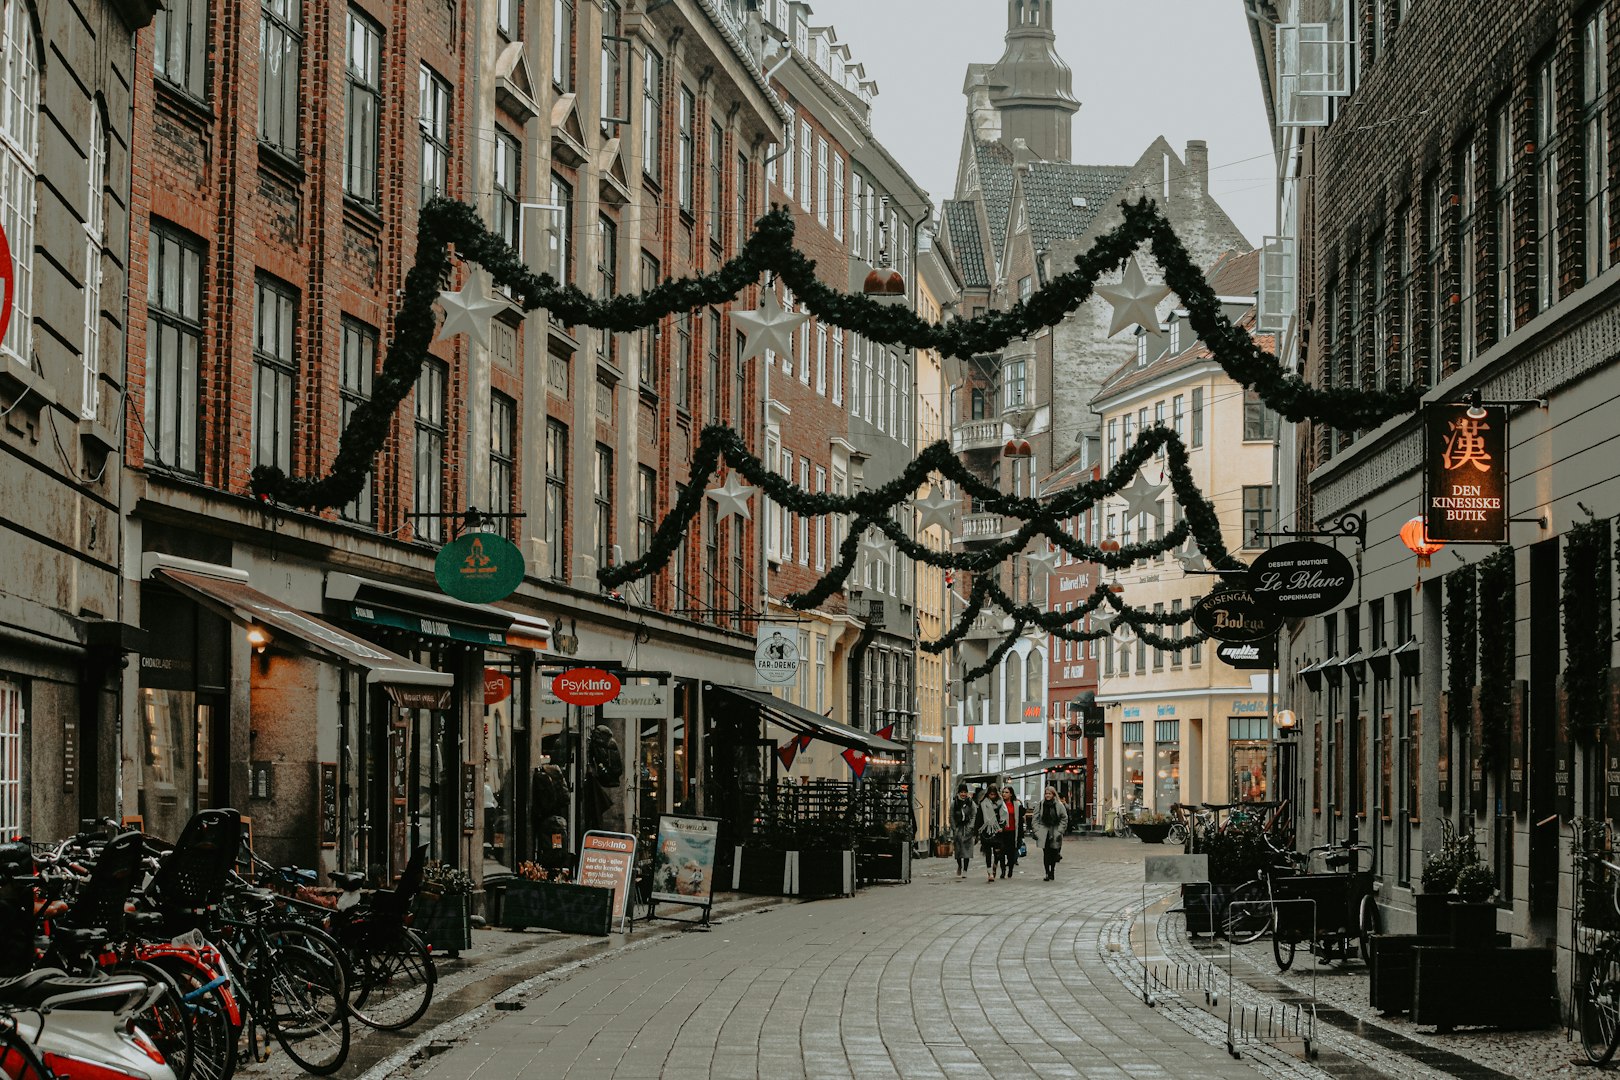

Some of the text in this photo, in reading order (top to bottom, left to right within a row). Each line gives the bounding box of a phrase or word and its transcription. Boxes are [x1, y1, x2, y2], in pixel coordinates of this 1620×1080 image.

[1442, 419, 1491, 472] 漢
[1452, 485, 1480, 496] DEN
[1432, 497, 1500, 509] KINESISKE
[1446, 510, 1487, 521] BUTIK
[1268, 558, 1329, 568] DESSERT BOUTIQUE
[1254, 569, 1345, 592] Le Blanc
[1279, 593, 1321, 601] COPENHAGEN
[1212, 609, 1265, 633] Bodega
[561, 678, 612, 692] PsykInfo
[592, 838, 627, 850] PsykInfo
